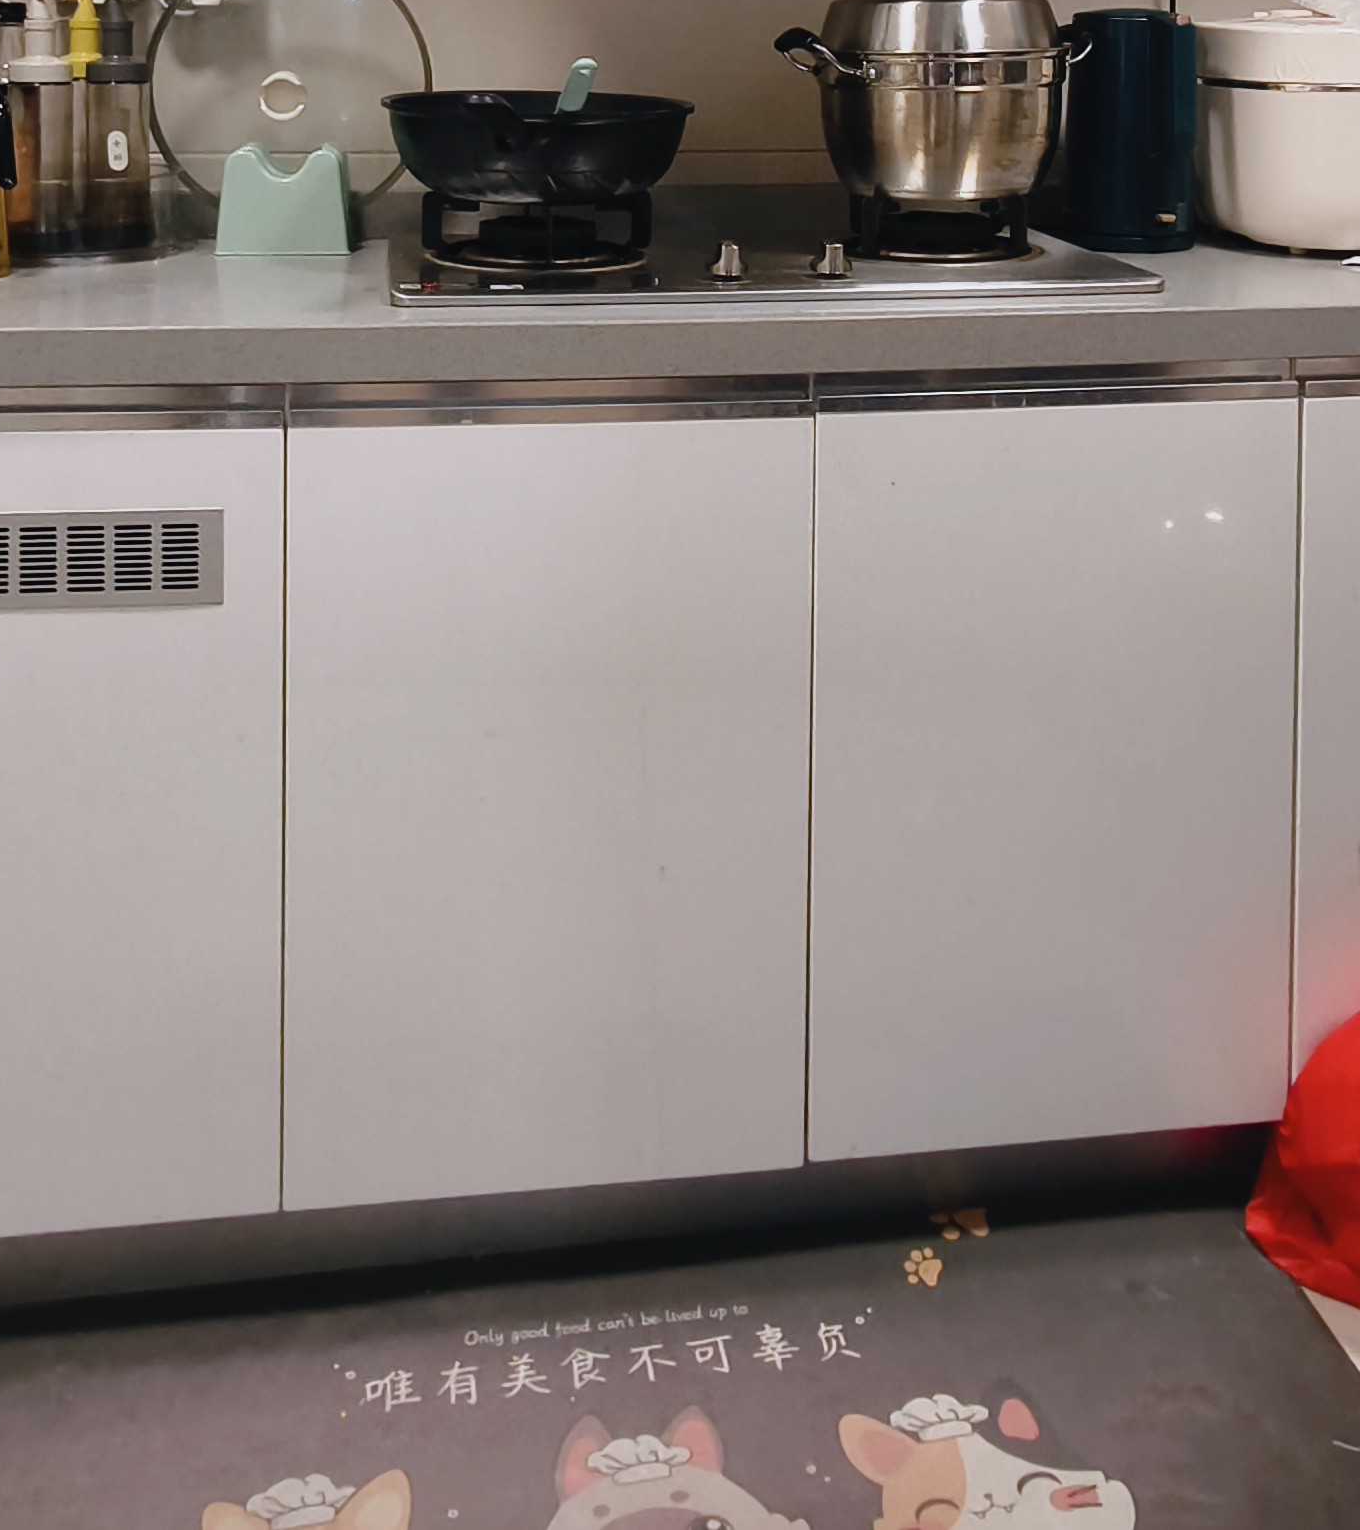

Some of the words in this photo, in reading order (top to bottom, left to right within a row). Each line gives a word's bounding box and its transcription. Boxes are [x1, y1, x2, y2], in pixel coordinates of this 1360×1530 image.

[464, 1329, 504, 1347] Only
[511, 1323, 550, 1345] good
[554, 1318, 591, 1339] food
[597, 1312, 635, 1332] can't
[640, 1310, 662, 1326] be
[664, 1304, 703, 1322] lived
[709, 1307, 727, 1321] up
[364, 1322, 861, 1412] 唯有美食不可辜负
